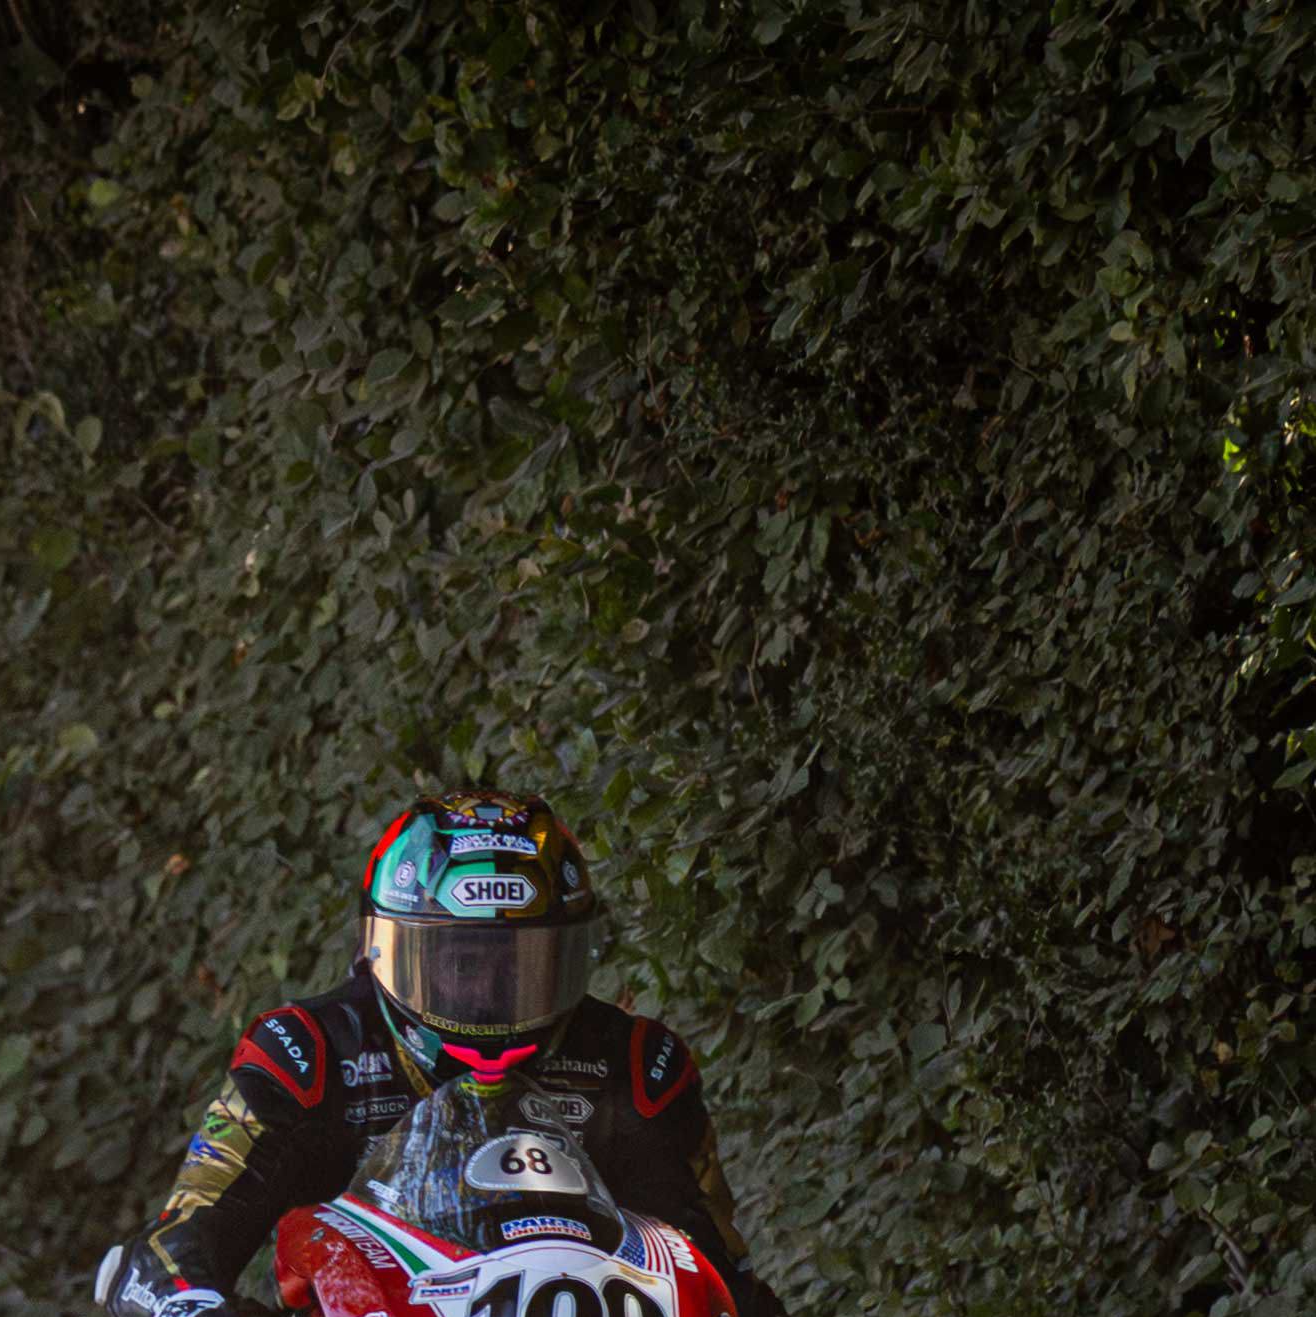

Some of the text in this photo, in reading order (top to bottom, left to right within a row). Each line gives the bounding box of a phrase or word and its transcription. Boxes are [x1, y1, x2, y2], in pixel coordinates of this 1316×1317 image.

[464, 881, 524, 901] SHOEI
[264, 1018, 309, 1073] SPADA
[500, 1147, 552, 1175] 68
[503, 1217, 588, 1233] PARTS
